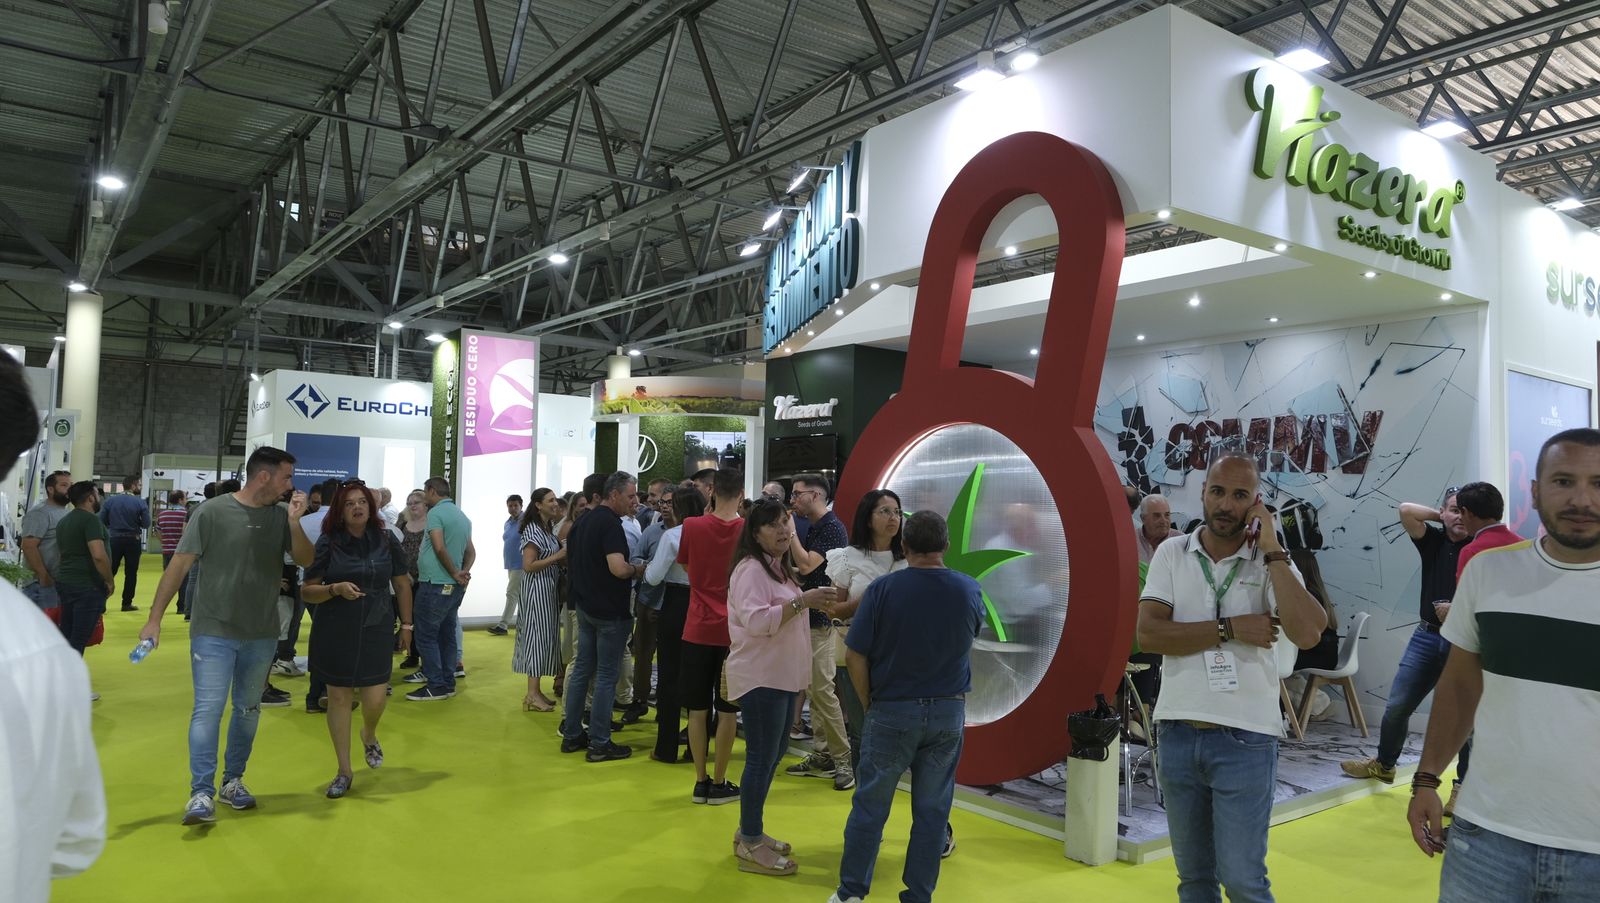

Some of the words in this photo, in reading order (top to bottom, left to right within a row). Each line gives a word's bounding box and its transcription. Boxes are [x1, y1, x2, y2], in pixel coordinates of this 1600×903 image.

[843, 140, 861, 213] Y
[1338, 215, 1389, 252] Seeds
[1403, 237, 1451, 271] Growth
[1546, 261, 1600, 318] surs
[467, 335, 479, 372] CERO
[337, 397, 432, 417] EUROCH
[465, 376, 477, 437] RESIDUO
